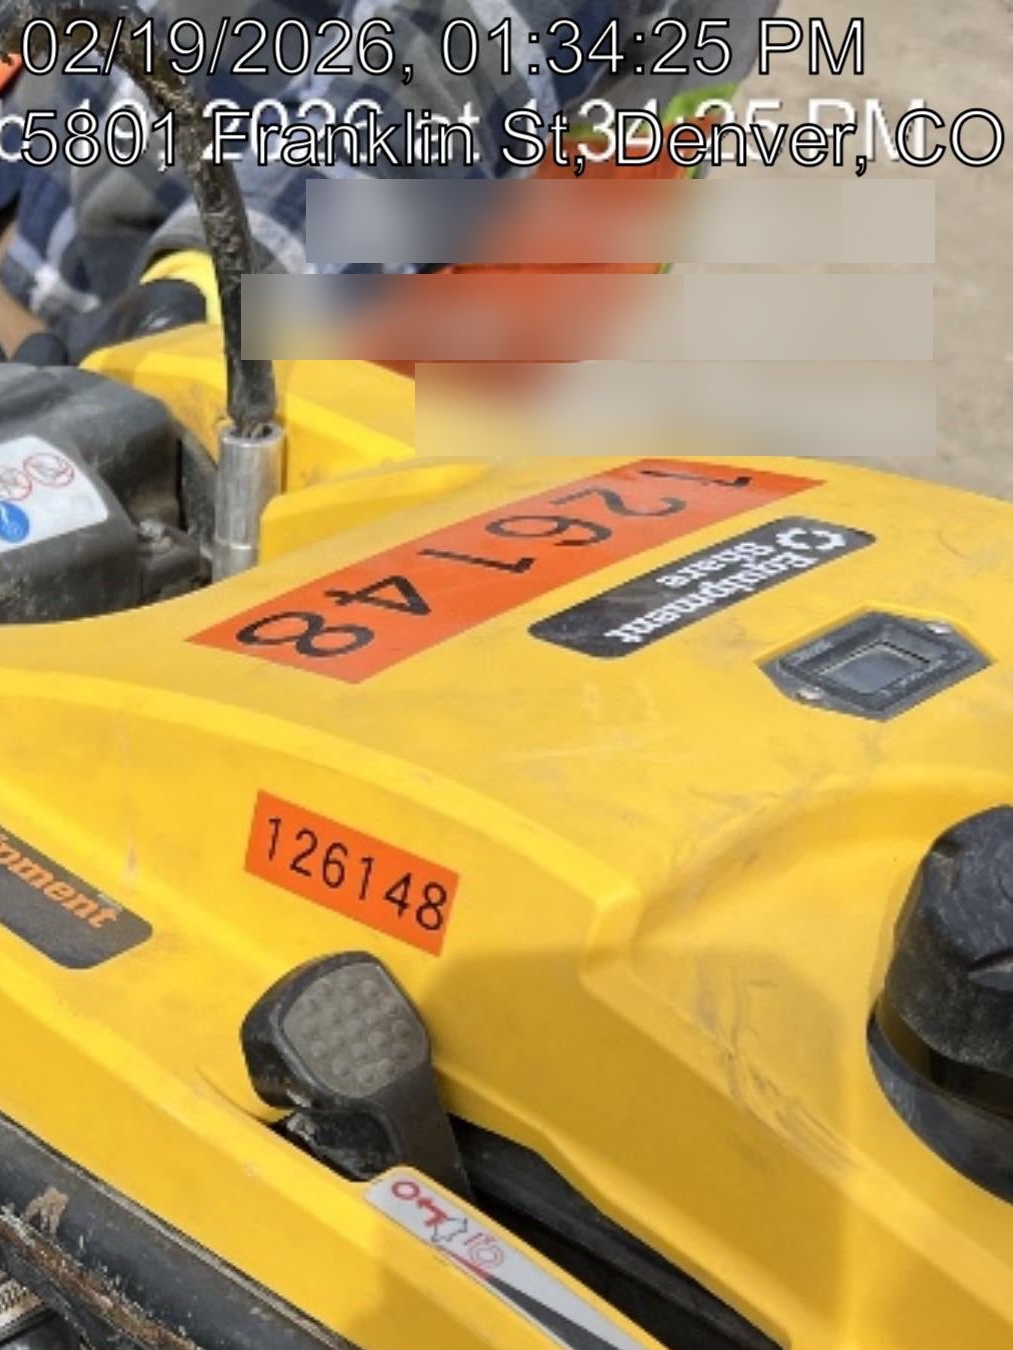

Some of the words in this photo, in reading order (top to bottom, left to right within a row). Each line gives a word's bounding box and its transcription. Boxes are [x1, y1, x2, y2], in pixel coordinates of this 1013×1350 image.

[235, 468, 758, 659] 126148
[602, 550, 816, 647] Equipment
[655, 541, 775, 589] Share
[267, 816, 450, 934] 126148
